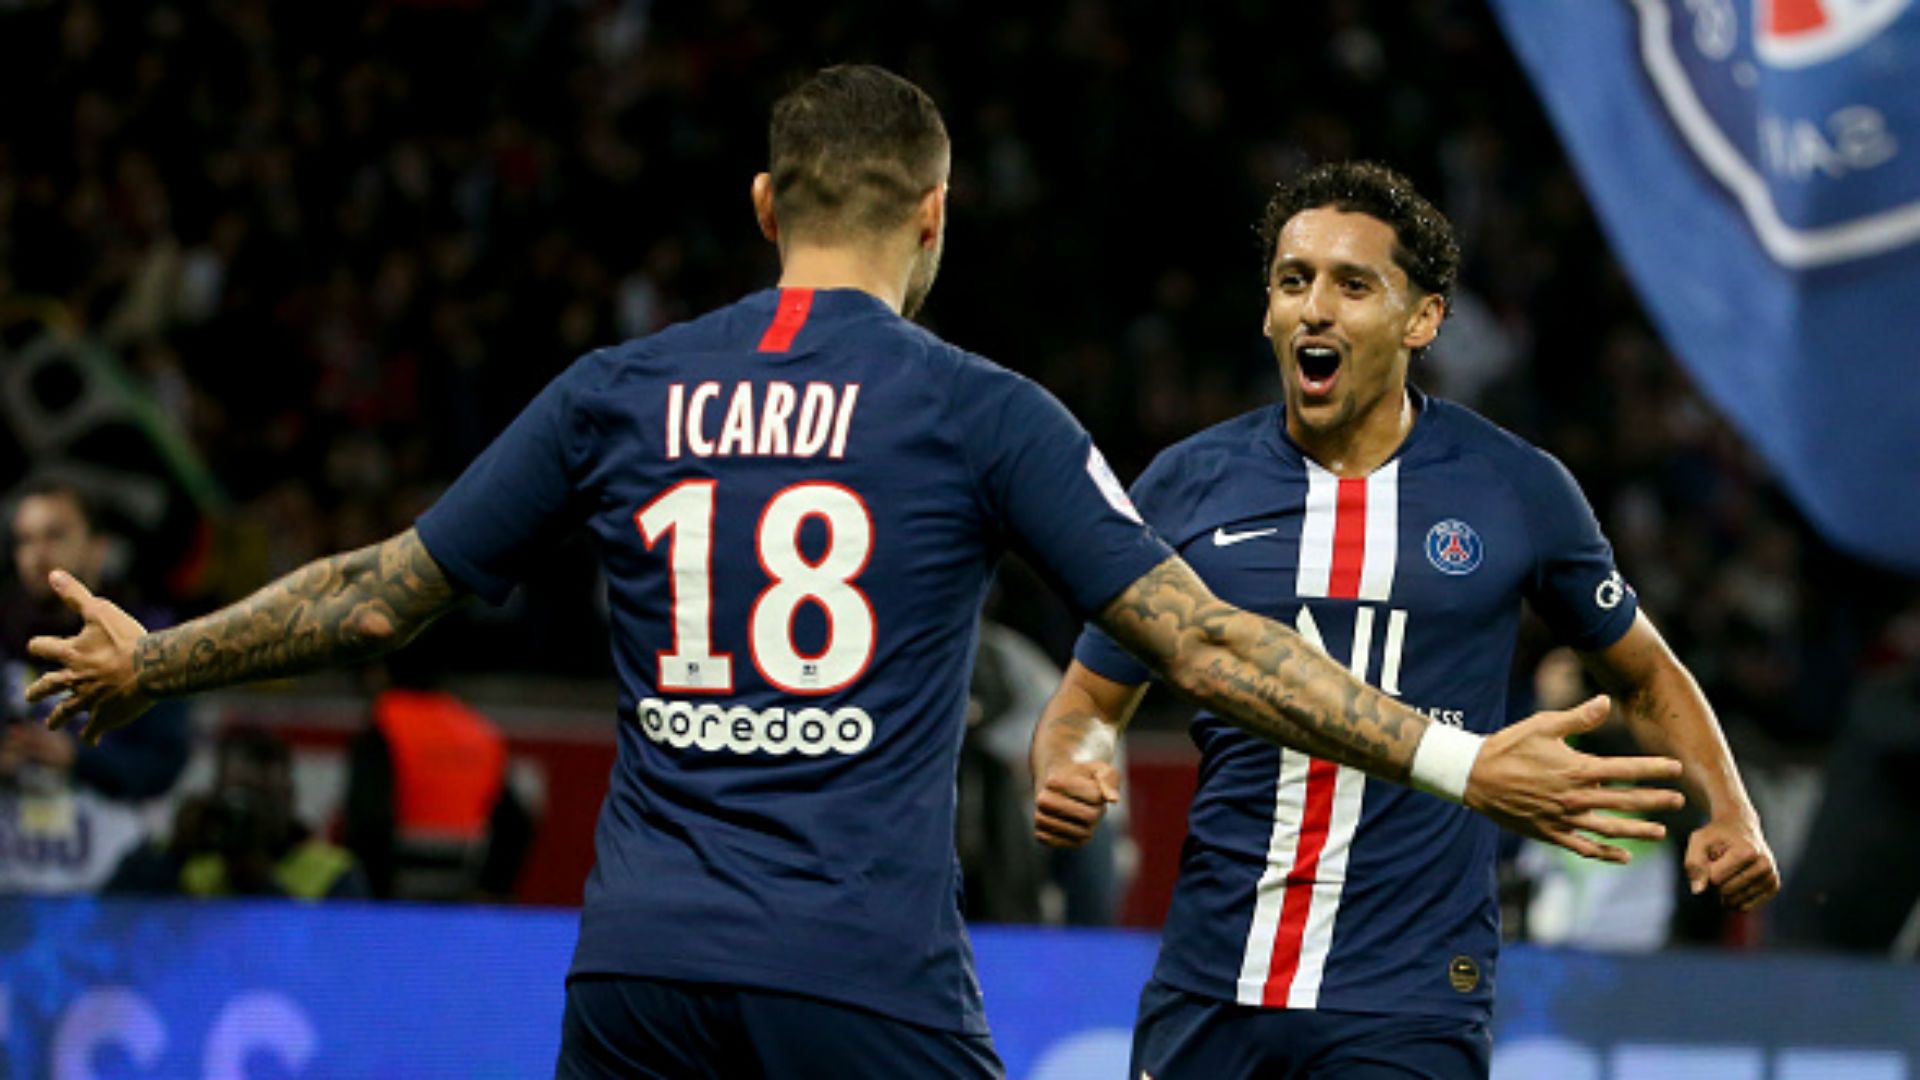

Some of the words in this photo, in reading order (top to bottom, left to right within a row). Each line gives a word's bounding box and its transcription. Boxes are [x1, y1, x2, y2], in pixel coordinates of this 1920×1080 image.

[664, 381, 860, 460] ICARDI
[633, 478, 878, 696] 18
[641, 701, 870, 750] ooredoo
